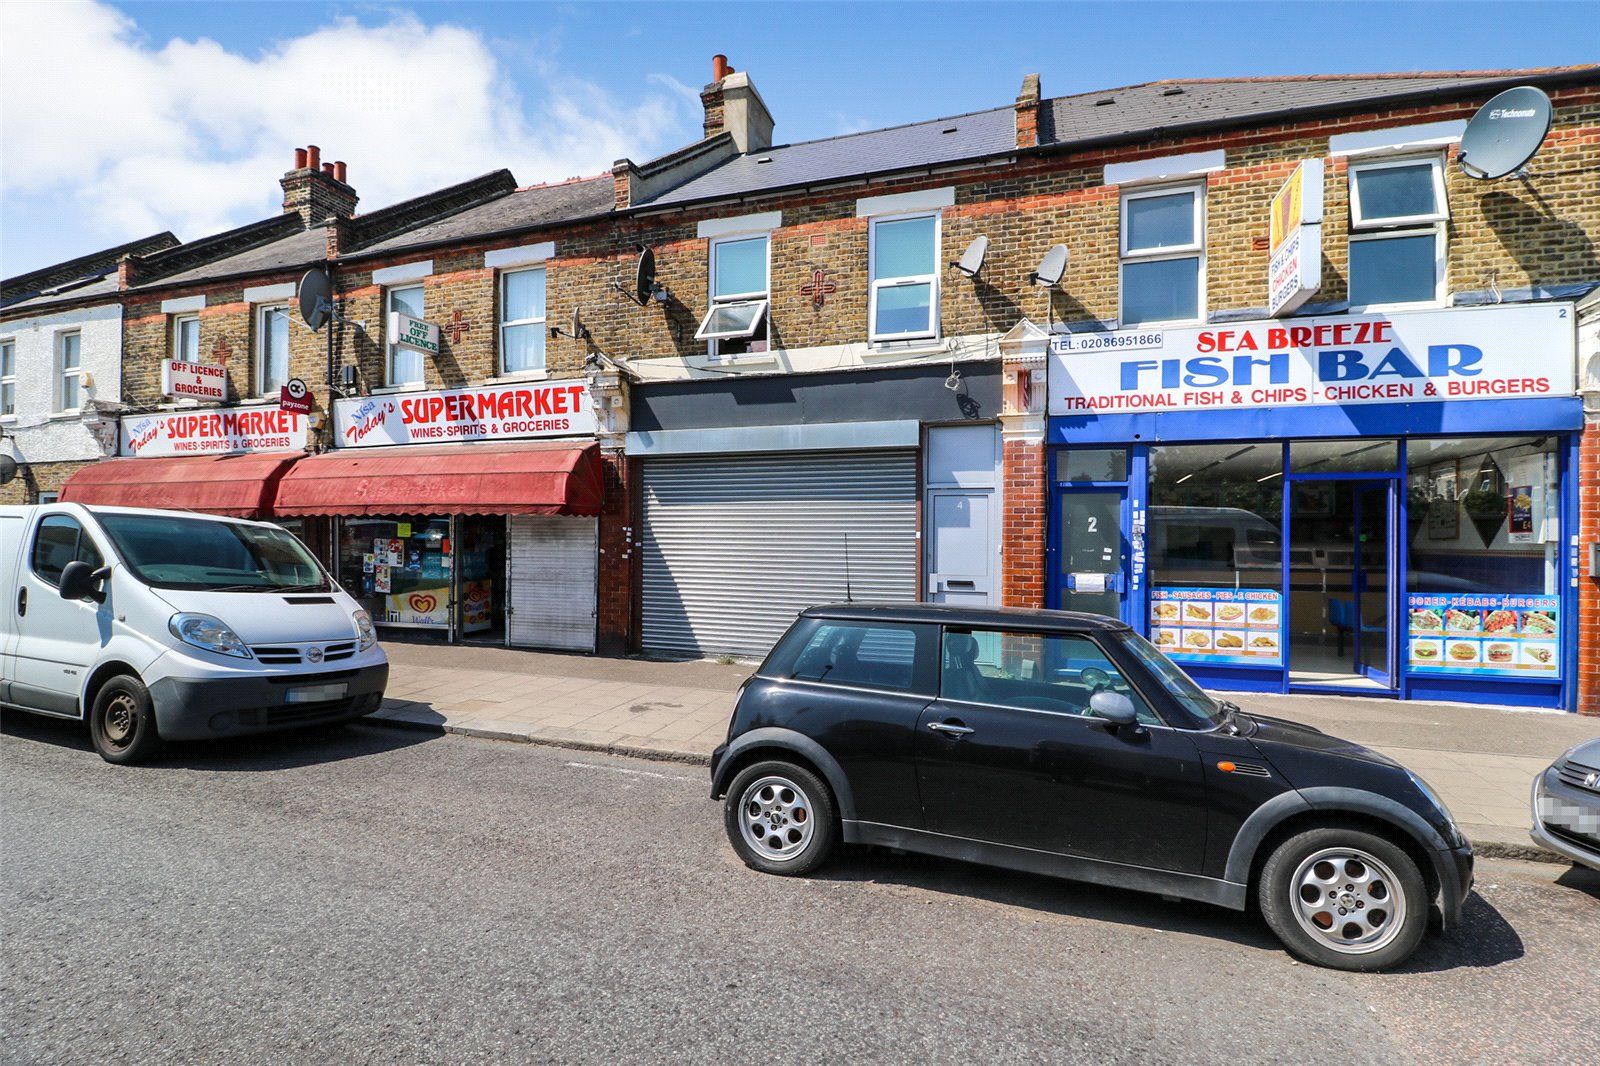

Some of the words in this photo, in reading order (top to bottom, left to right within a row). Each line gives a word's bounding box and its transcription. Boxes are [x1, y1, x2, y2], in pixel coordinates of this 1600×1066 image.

[1272, 256, 1297, 293] CHICKEN
[1272, 274, 1298, 310] BURGERS
[1559, 309, 1567, 318] 2
[408, 320, 429, 331] FREE
[410, 328, 428, 339] OFF
[400, 333, 438, 351] LICENCE
[1197, 330, 1258, 352] SEA
[1268, 321, 1392, 350] BREEZE
[171, 362, 187, 373] OFF
[190, 365, 224, 378] LICENCE
[1120, 354, 1290, 391] FISH
[1319, 344, 1483, 382] BAR
[196, 376, 202, 384] &
[175, 383, 222, 397] GROCERIES
[1065, 394, 1176, 410] TRADITIONAL
[1184, 392, 1224, 405] FISH
[1231, 391, 1243, 404] &
[1251, 388, 1307, 403] CHIPS
[1324, 383, 1413, 400] CHICKEN
[1424, 383, 1437, 396] &
[1448, 378, 1550, 396] BURGERS
[282, 400, 309, 410] payzone
[351, 401, 375, 422] Nisa
[402, 386, 585, 425] SUPERMARKET
[132, 418, 151, 436] Nisa
[167, 410, 300, 439] SUPERMARKET
[346, 401, 395, 443] Today's
[491, 423, 499, 434] &
[503, 419, 570, 433] GROCERIES
[128, 420, 165, 454] Today's
[233, 441, 239, 449] &
[241, 437, 290, 449] GROCERIES
[1088, 517, 1098, 532] 2
[1152, 591, 1168, 599] FISH
[1245, 592, 1278, 600] CHICKEN
